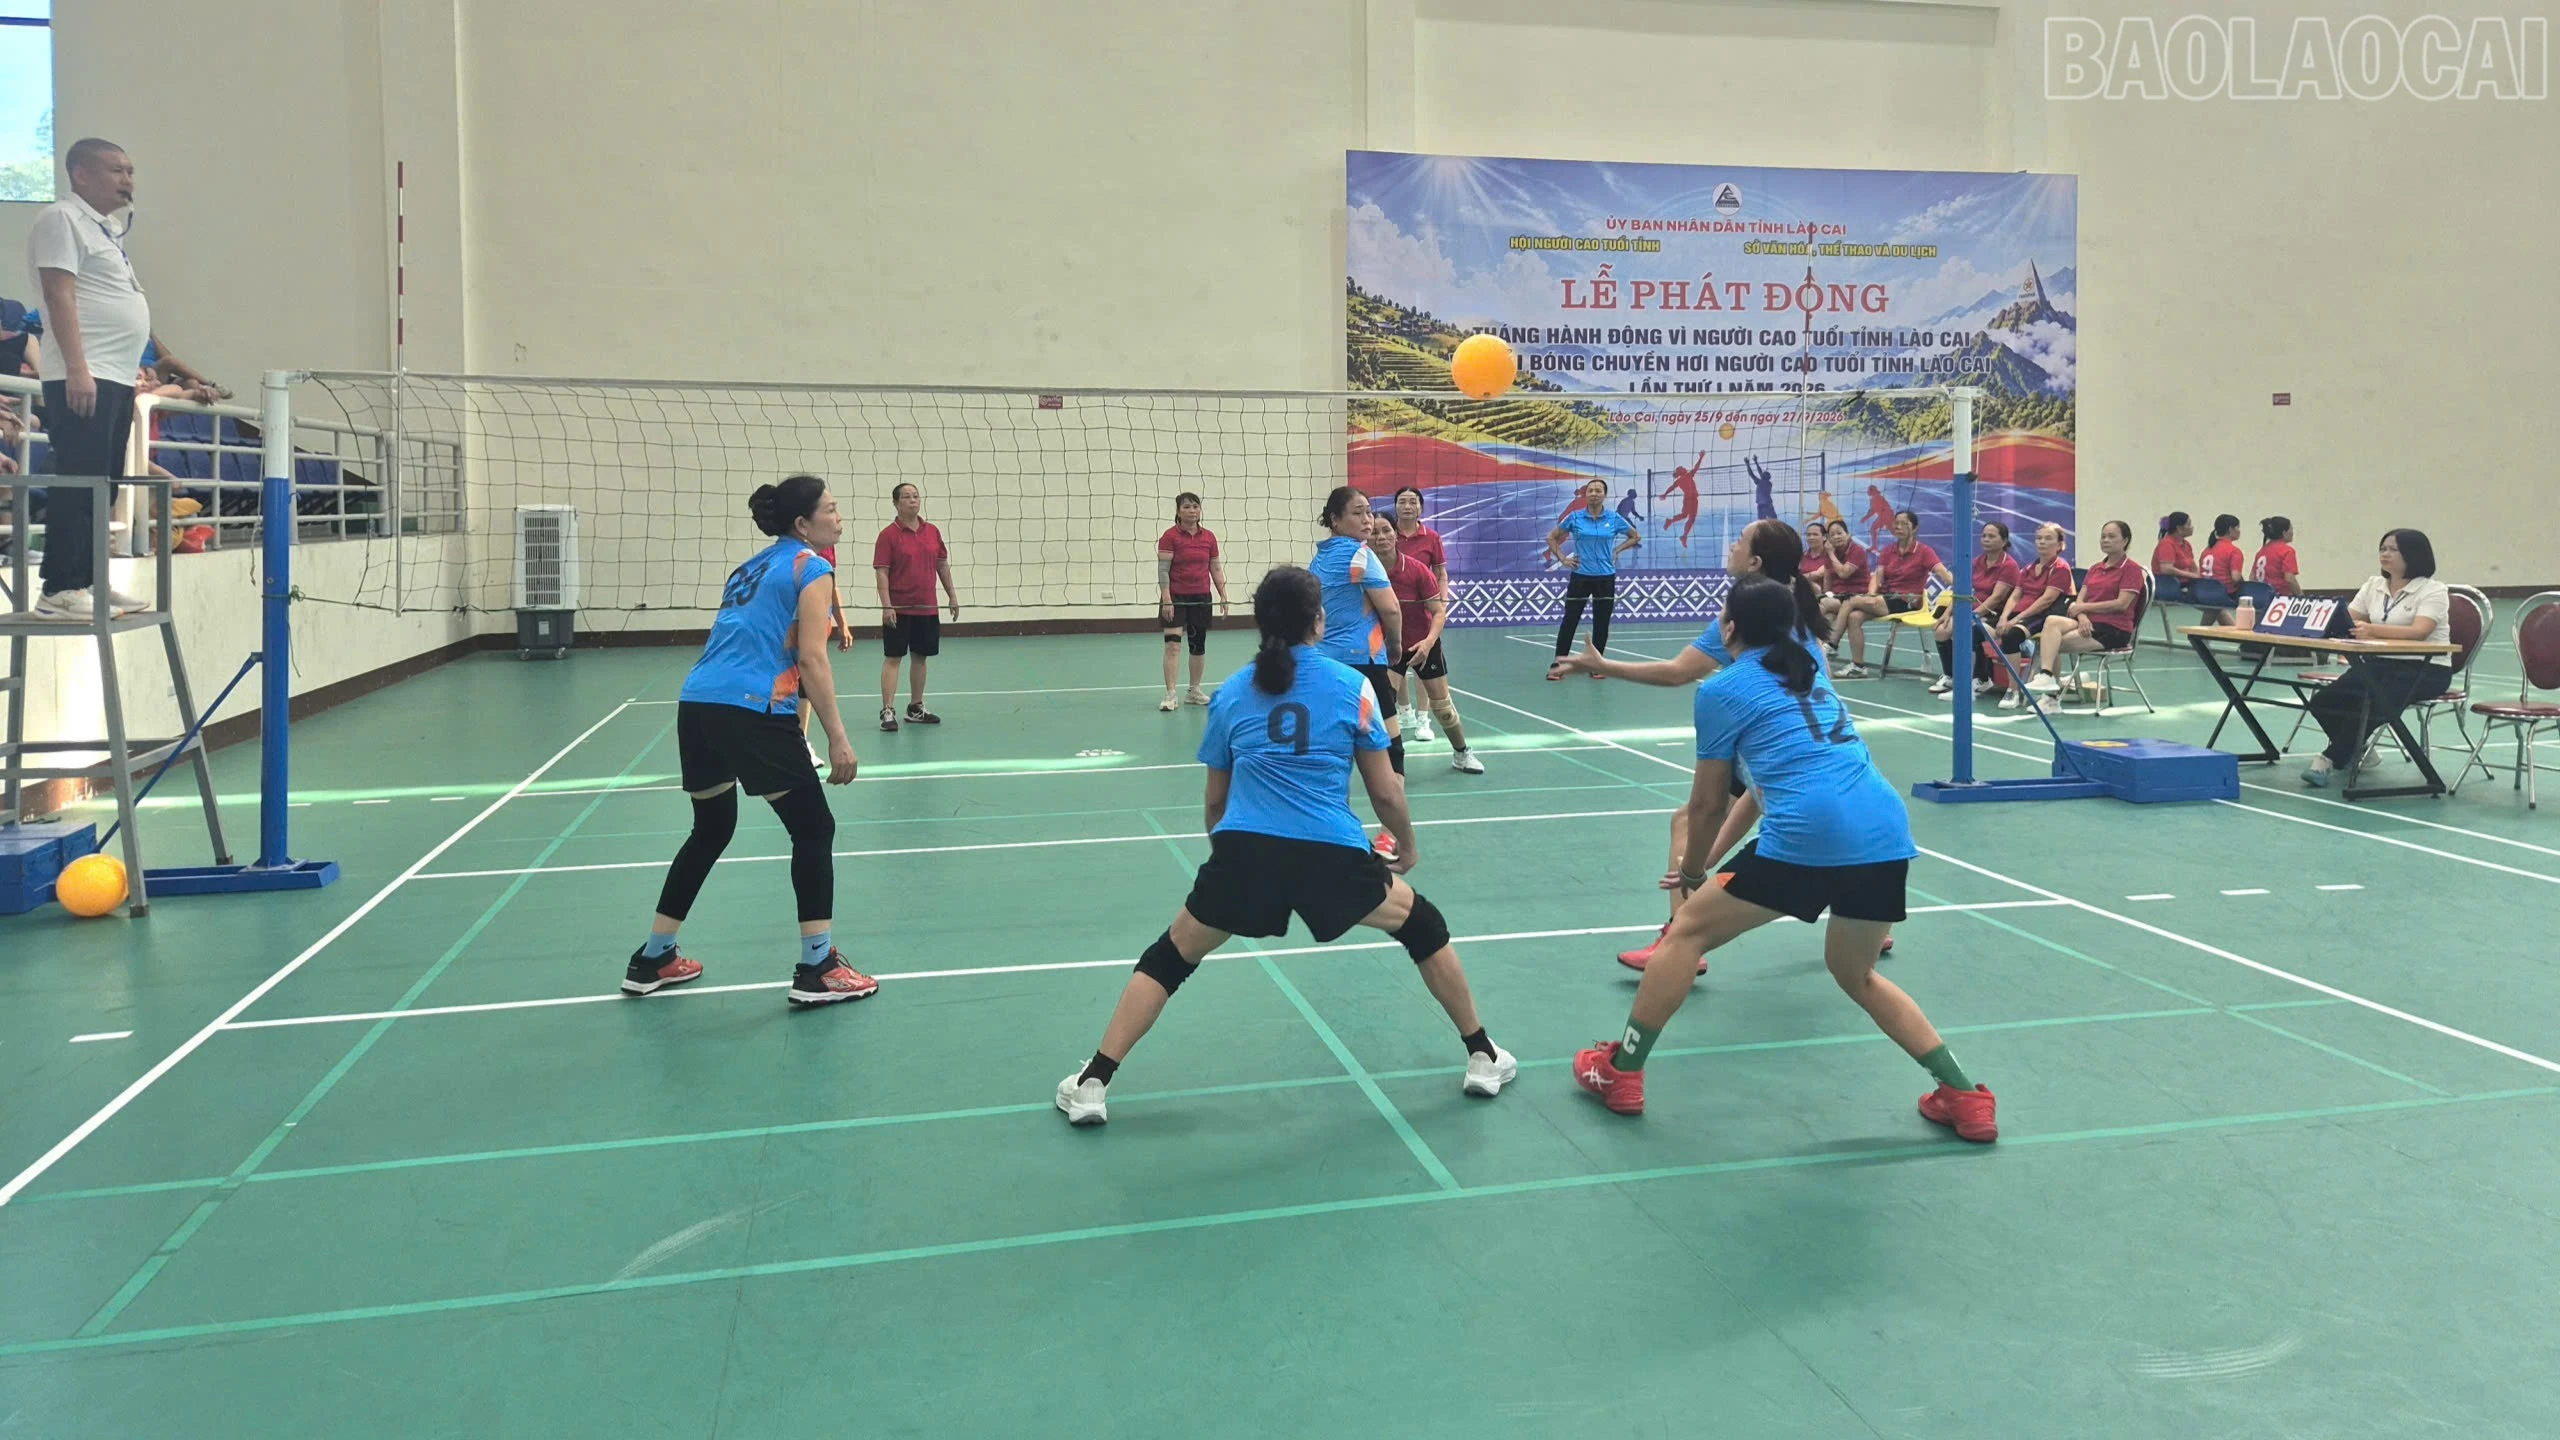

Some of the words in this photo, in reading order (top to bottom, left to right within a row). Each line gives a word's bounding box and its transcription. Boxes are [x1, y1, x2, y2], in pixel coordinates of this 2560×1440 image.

[1606, 215, 1627, 230] ỦY
[1631, 219, 1663, 231] BAN
[1667, 218, 1710, 232] NHÂN
[1713, 219, 1745, 233] DÂN
[1749, 219, 1784, 234] TỈNH
[1787, 220, 1818, 235] LÀO
[1821, 224, 1846, 235] CAI
[1510, 235, 1531, 251] HỘI
[1534, 236, 1572, 250] NGƯỜI
[1576, 239, 1599, 250] CAO
[1603, 235, 1630, 251] TUỔI
[1632, 237, 1660, 252] TỈNH
[1744, 239, 1762, 254] SỞ
[1762, 240, 1786, 255] VĂN
[1818, 240, 1840, 256] THỂ
[1844, 244, 1872, 256] THAO
[1875, 242, 1890, 257] VÀ
[1893, 245, 1909, 257] DU
[1910, 245, 1937, 259] LỊCH
[1561, 263, 1617, 309] LỄ
[1630, 271, 1751, 311] PHÁT
[1763, 273, 1889, 320] ĐỘNG
[1547, 324, 1601, 344] HÀNH
[1608, 325, 1662, 348] ĐỘNG
[1668, 325, 1686, 345] VÌ
[1693, 326, 1752, 346] NGƯỜI
[1759, 330, 1796, 346] CAO
[1850, 326, 1893, 347] TỈNH
[1900, 328, 1933, 347] LÀO
[1940, 331, 1970, 347] CAI
[1530, 351, 1585, 371] BÓNG
[1592, 350, 1670, 372] CHUYỀN
[1676, 354, 1708, 372] HƠI
[1715, 353, 1774, 372] NGƯỜI
[1781, 356, 1817, 372] CAO
[1824, 351, 1865, 373] TUỔI
[1872, 352, 1914, 373] TỈNH
[1920, 353, 1955, 373] LÀO
[1959, 356, 1992, 373] CAI
[1729, 378, 1773, 392] NĂM
[1609, 411, 1631, 422] Lào
[1635, 411, 1658, 424] Cai,
[1661, 412, 1691, 425] ngày
[1694, 412, 1723, 423] 25/9
[1725, 410, 1748, 422] đến
[1750, 412, 1780, 425] ngày
[2202, 554, 2214, 577] 9
[2256, 556, 2267, 583] 8
[2267, 602, 2287, 624] 6
[2315, 605, 2332, 627] 11
[1785, 686, 1859, 745] 12
[1267, 702, 1311, 756] 9
[1622, 1025, 1641, 1055] C
